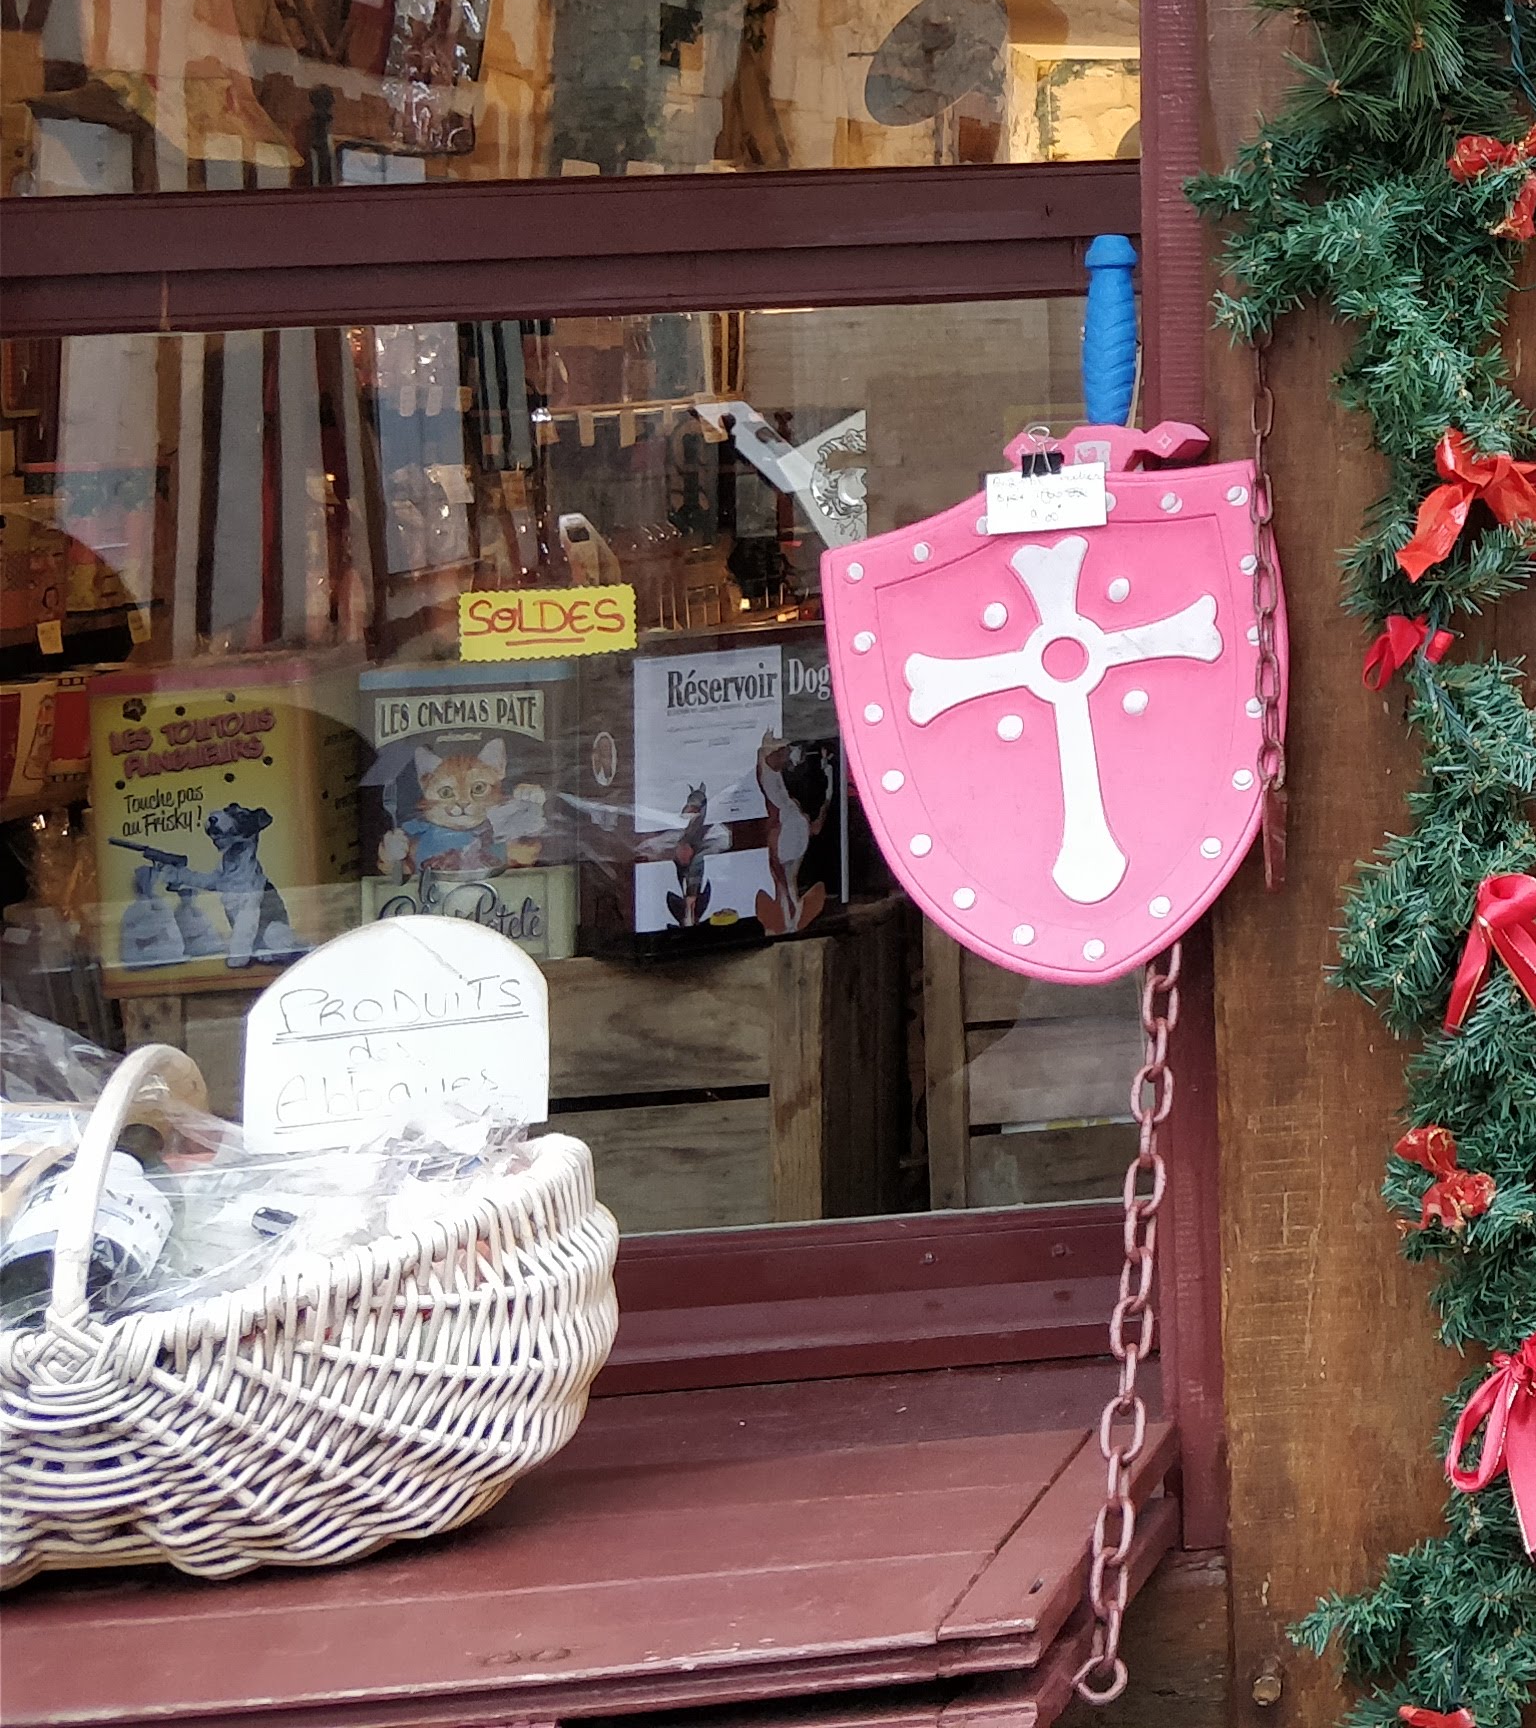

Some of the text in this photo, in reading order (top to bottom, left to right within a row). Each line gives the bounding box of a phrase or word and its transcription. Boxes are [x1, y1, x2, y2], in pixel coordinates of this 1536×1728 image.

[463, 598, 626, 637] SOLDES
[666, 662, 779, 710] Réservoir
[381, 703, 410, 738] LES
[108, 725, 154, 756] LES
[124, 786, 204, 814] Touche pas
[122, 820, 143, 837] au
[276, 974, 522, 1034] PRODUITS
